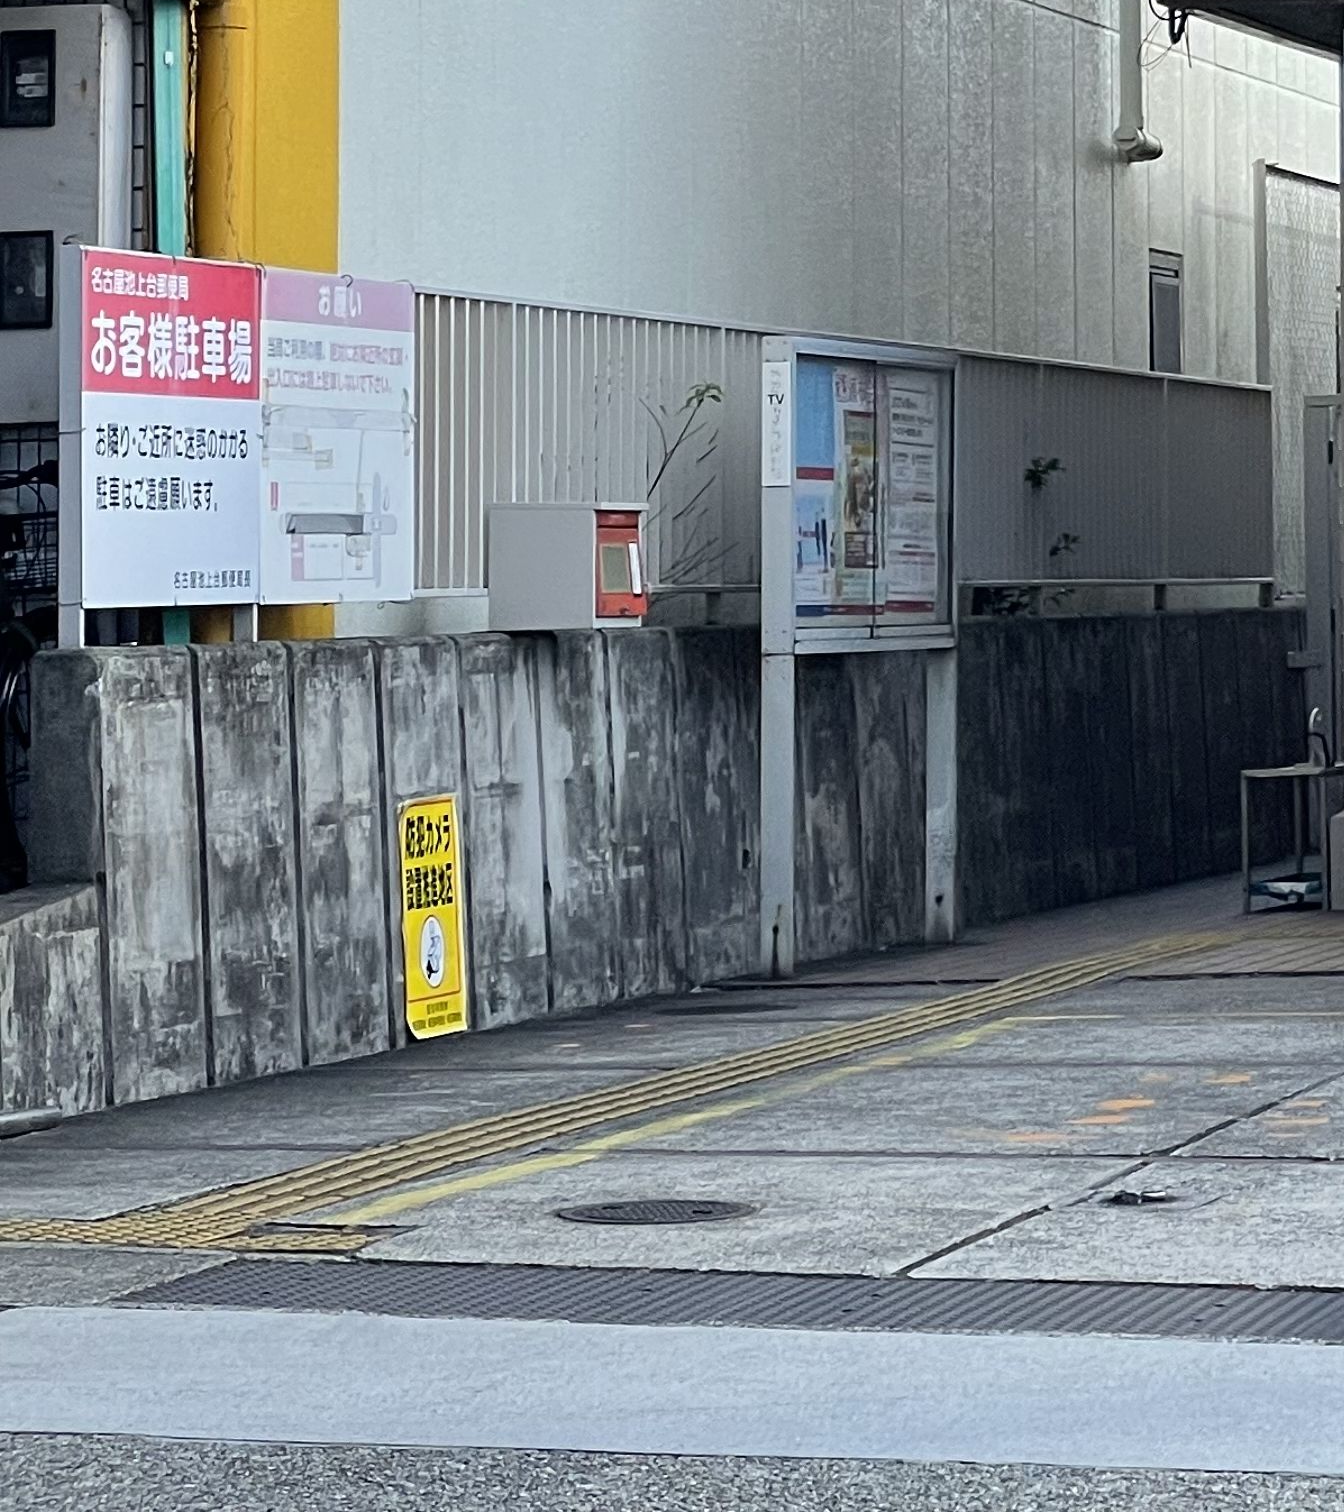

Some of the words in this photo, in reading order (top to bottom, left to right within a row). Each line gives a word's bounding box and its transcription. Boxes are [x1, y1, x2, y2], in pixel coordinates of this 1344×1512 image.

[91, 309, 252, 384] お客様駐車場
